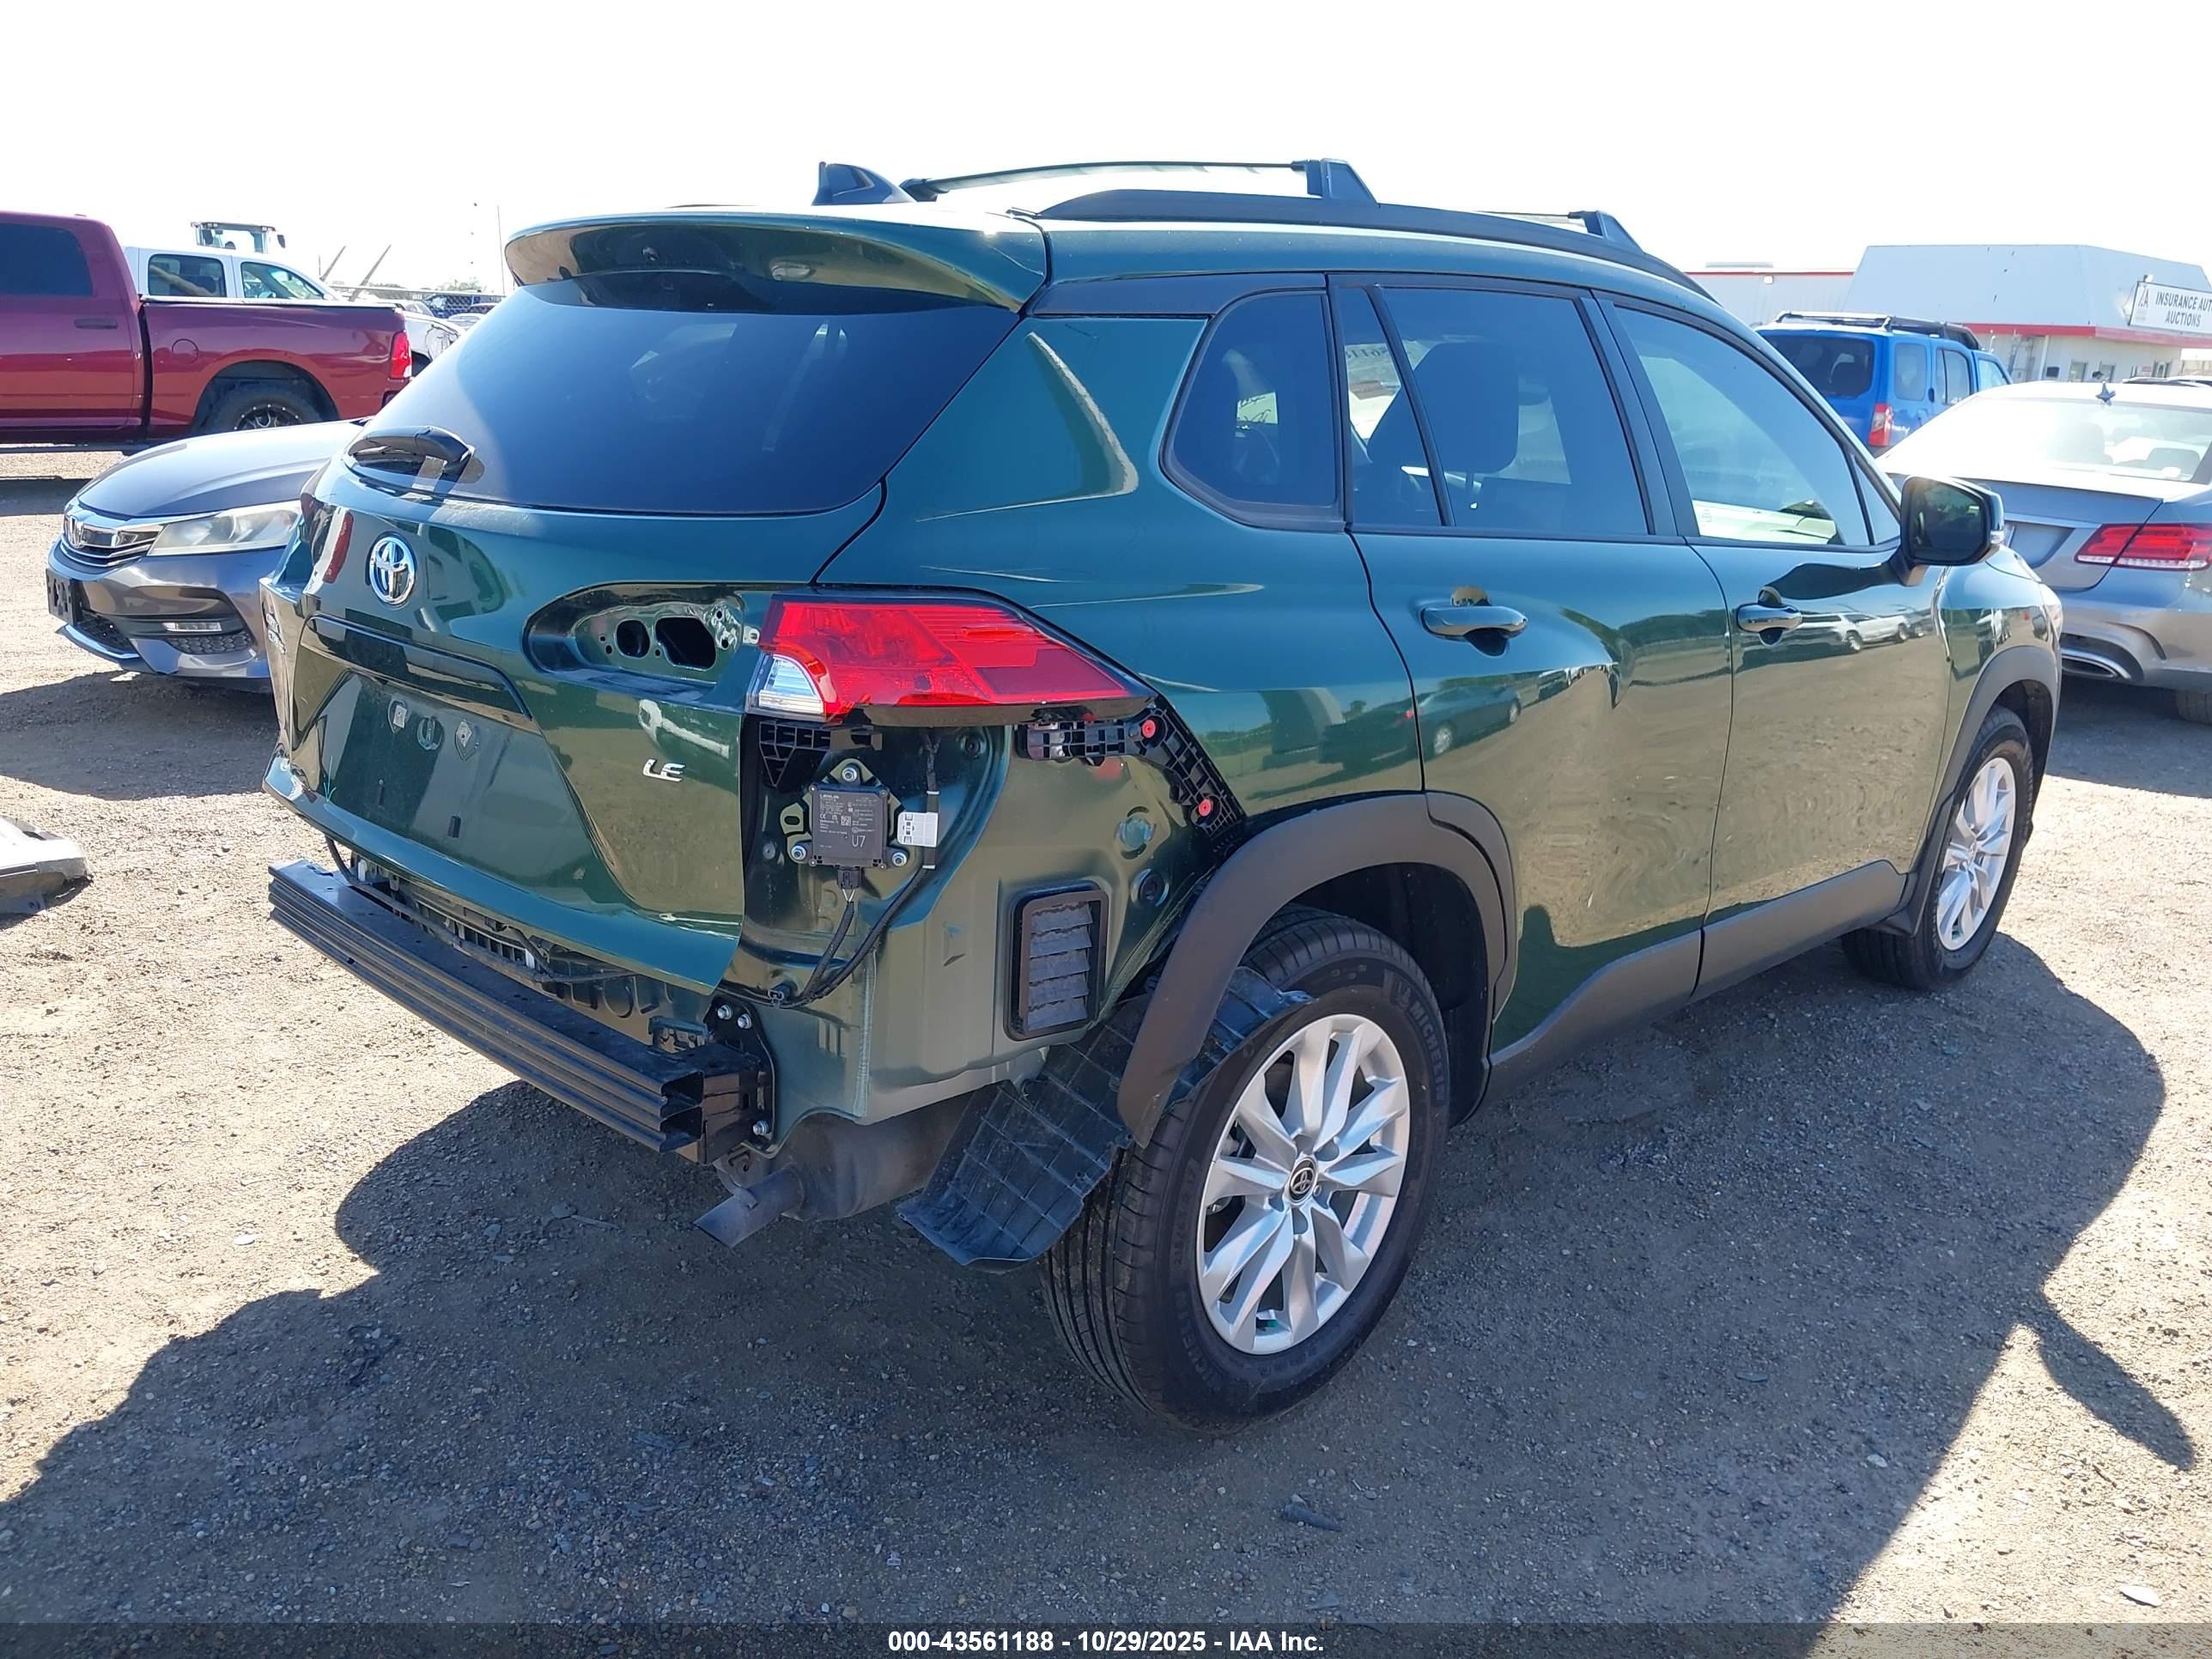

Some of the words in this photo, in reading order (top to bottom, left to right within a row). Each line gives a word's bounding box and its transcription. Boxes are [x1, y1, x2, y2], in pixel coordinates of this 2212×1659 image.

[2155, 291, 2198, 310] INSURANCE
[2198, 297, 2212, 313] AUT
[2165, 310, 2202, 327] AUCTIONS
[642, 758, 686, 782] LE
[852, 835, 866, 848] U7
[1409, 1000, 1447, 1102] MICHELIN
